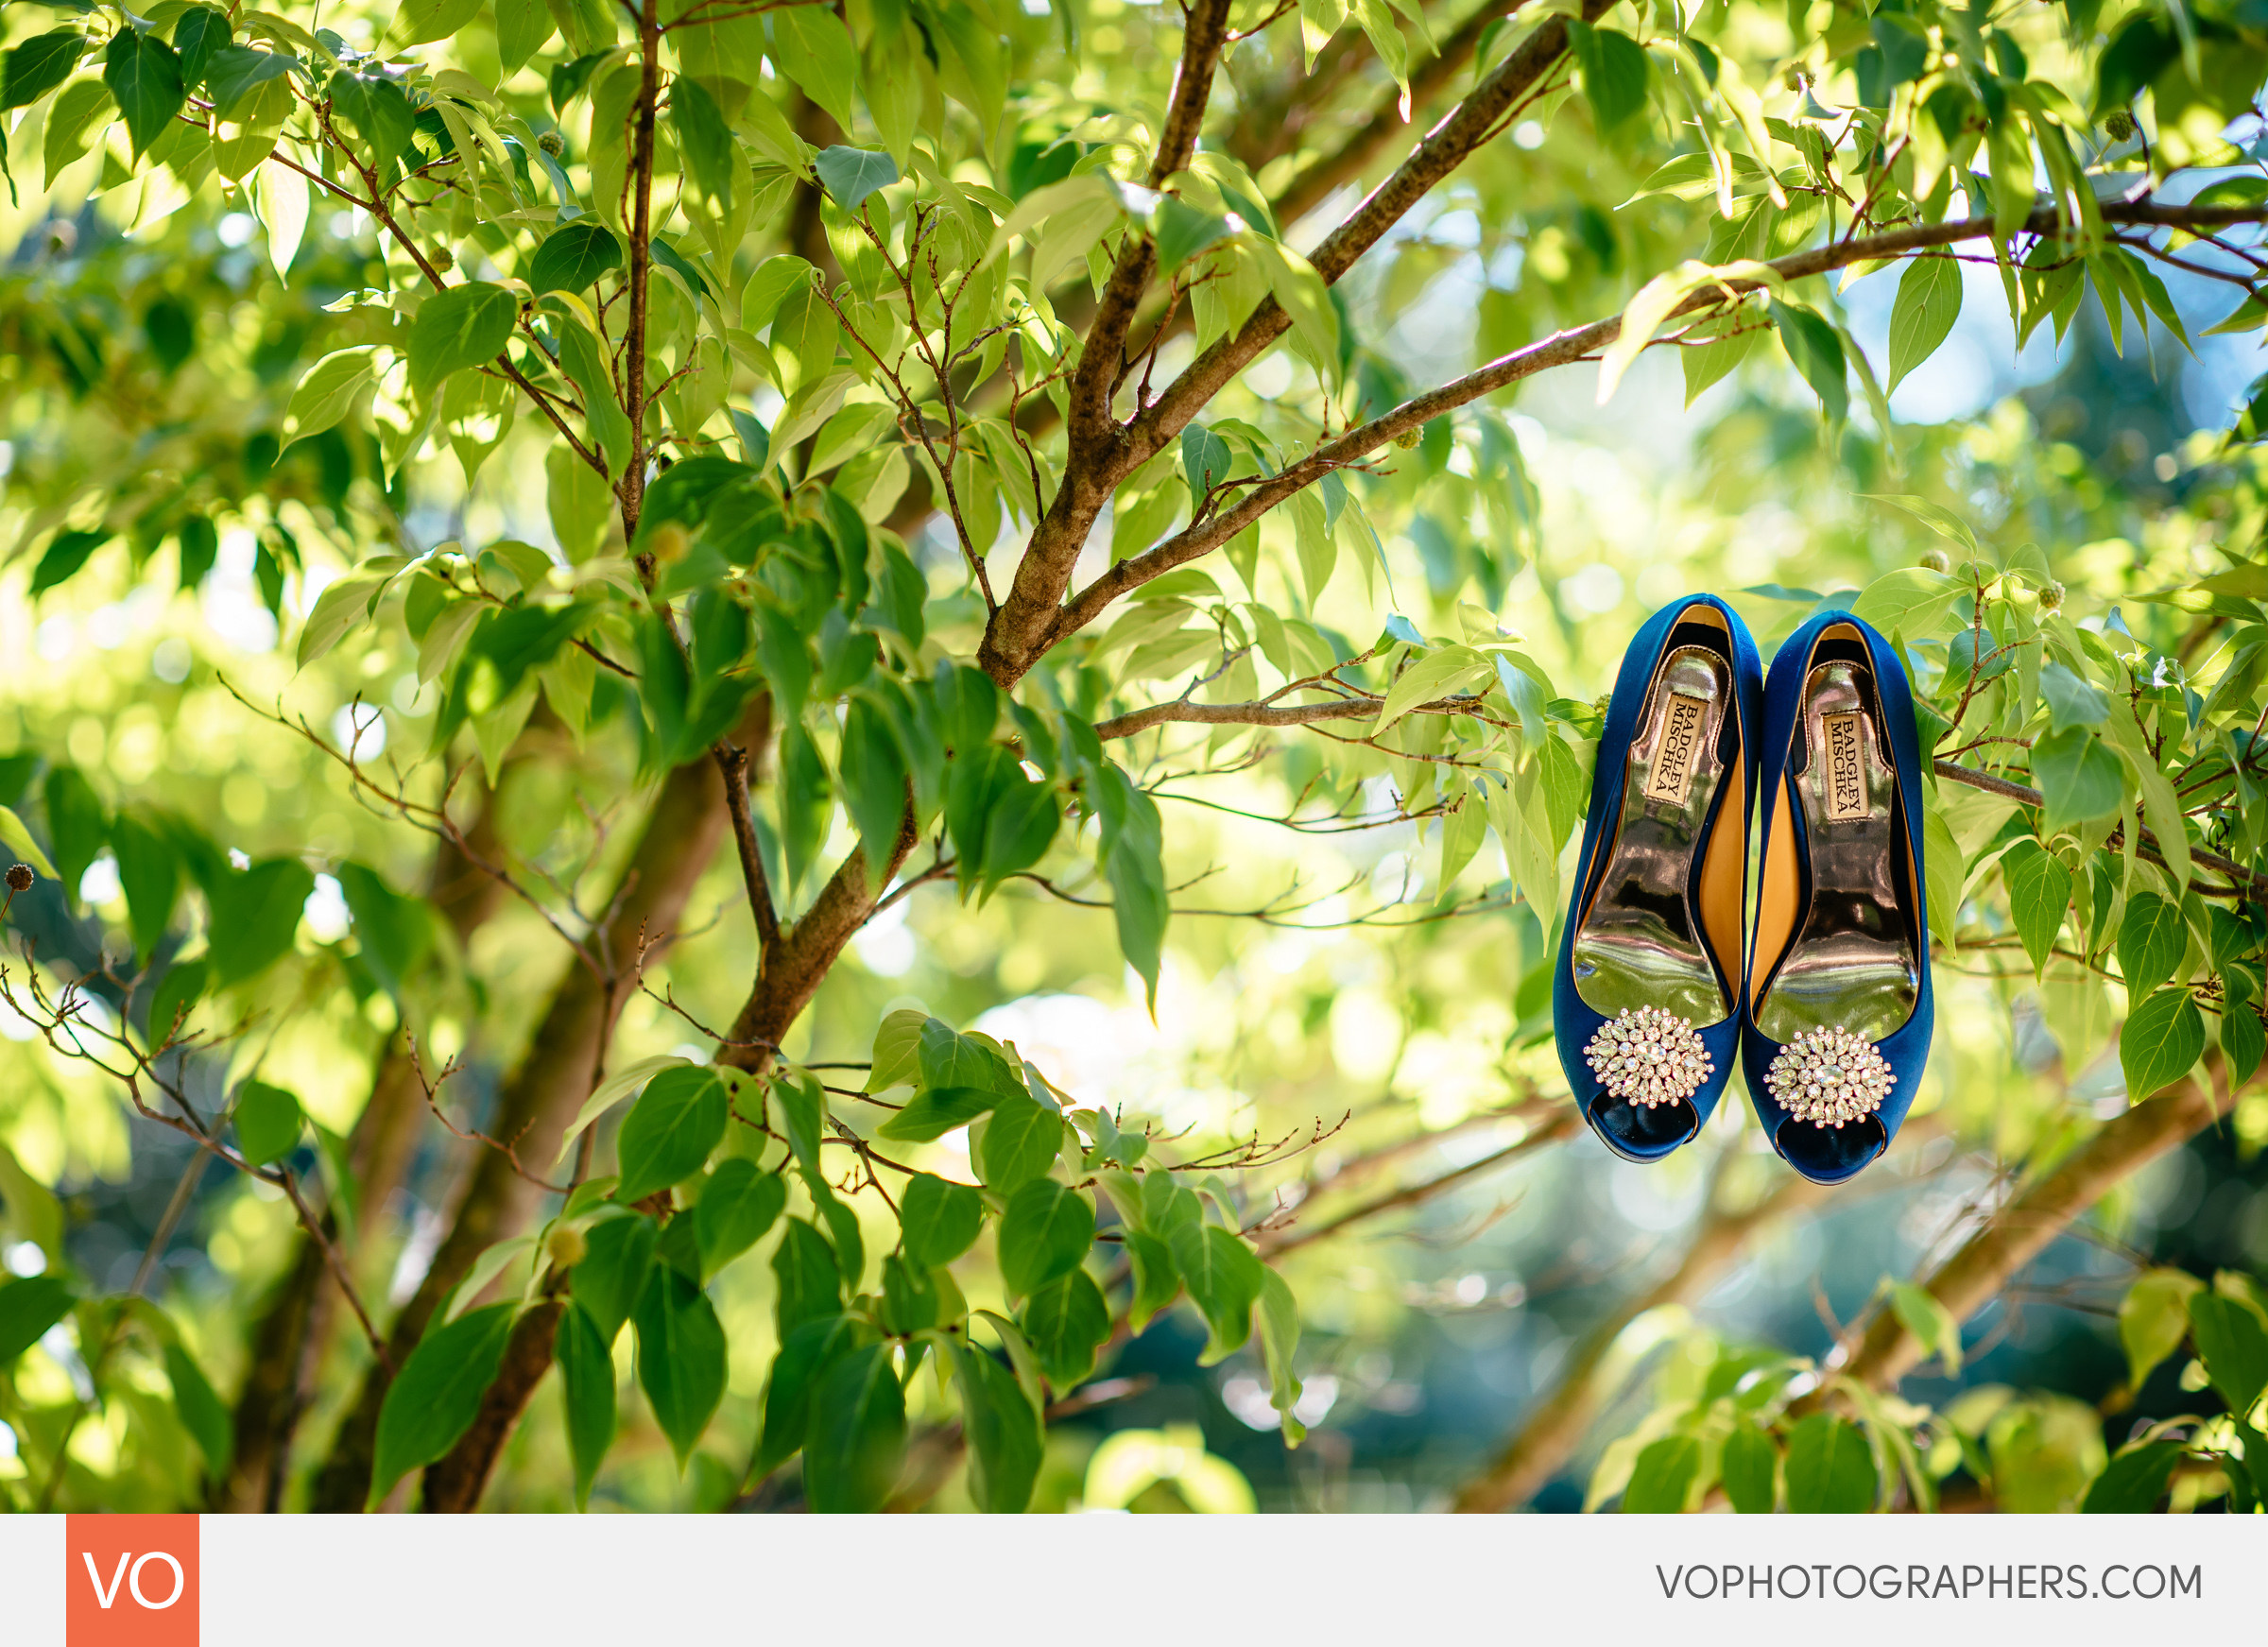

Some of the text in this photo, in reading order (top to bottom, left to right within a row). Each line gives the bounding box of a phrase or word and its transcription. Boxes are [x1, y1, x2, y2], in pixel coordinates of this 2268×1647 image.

[1656, 701, 1688, 792] MISCHKA
[1667, 704, 1699, 798] BADGLEY
[1830, 721, 1848, 815] MISCHKA
[1842, 719, 1861, 812] BADGLEY
